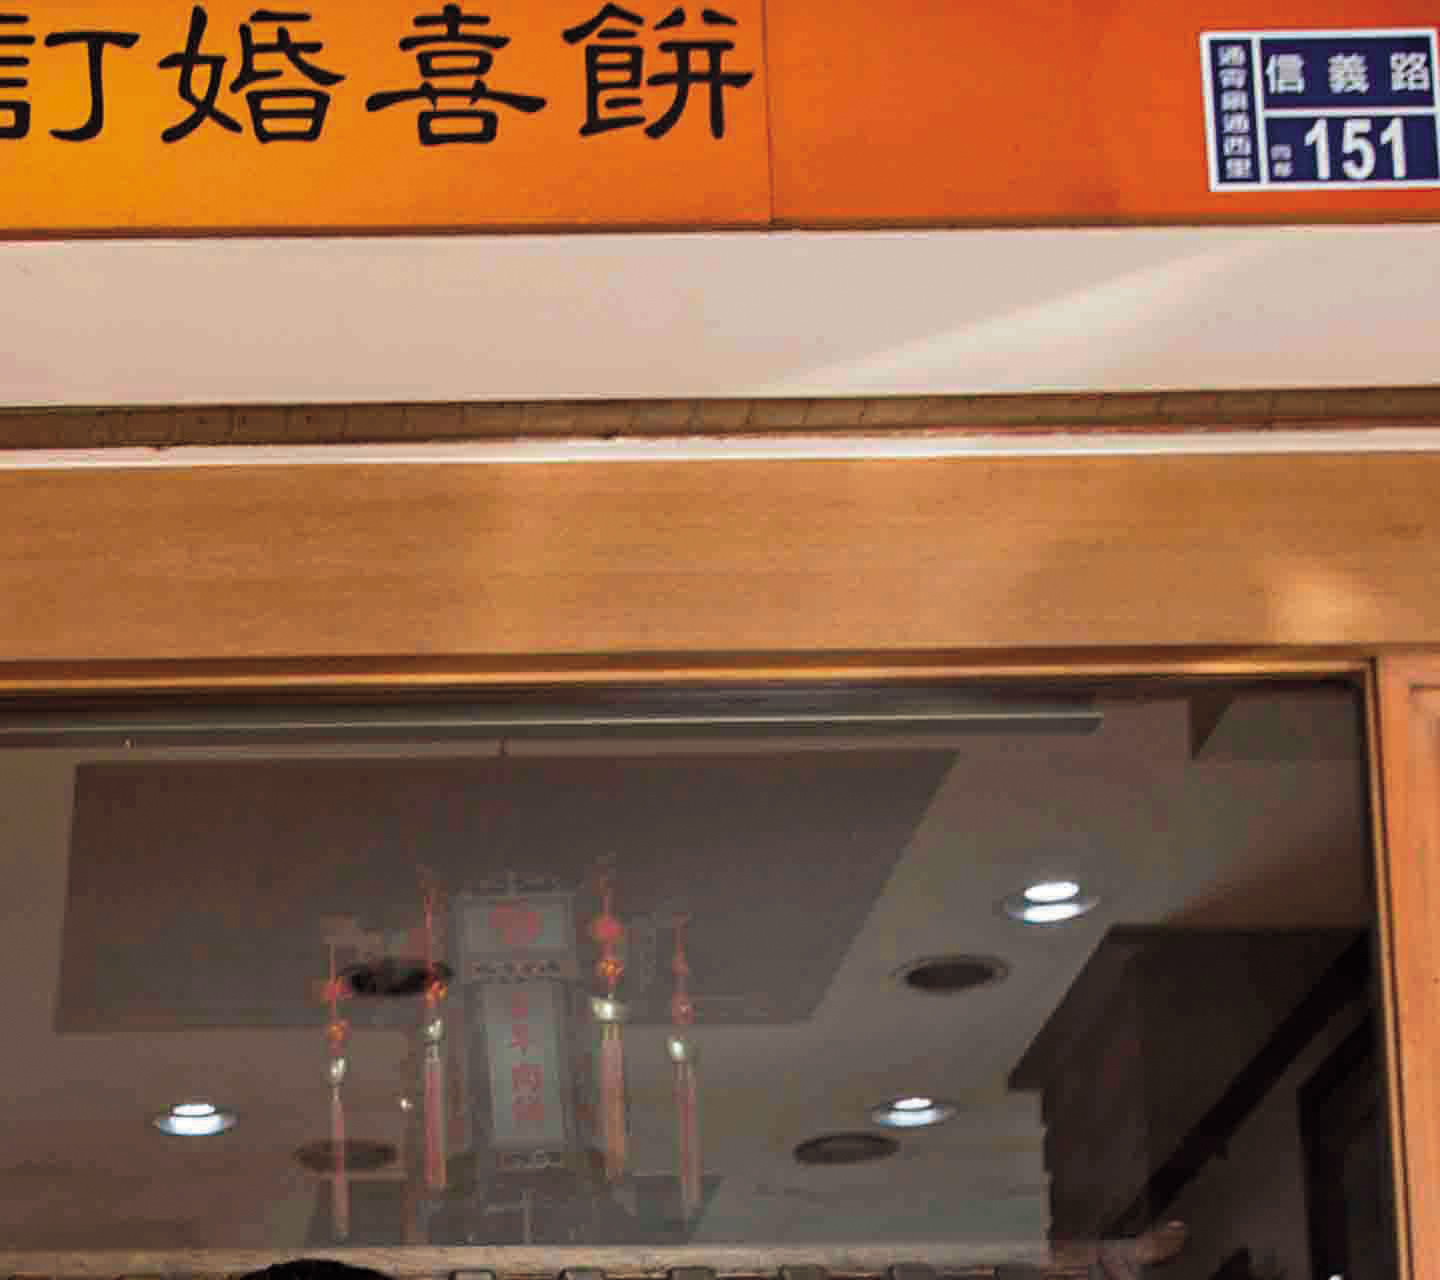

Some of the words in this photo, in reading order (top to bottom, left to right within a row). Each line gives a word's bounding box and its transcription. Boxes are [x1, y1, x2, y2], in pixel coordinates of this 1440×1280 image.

[1266, 51, 1430, 95] 信義路
[1303, 115, 1407, 181] 151
